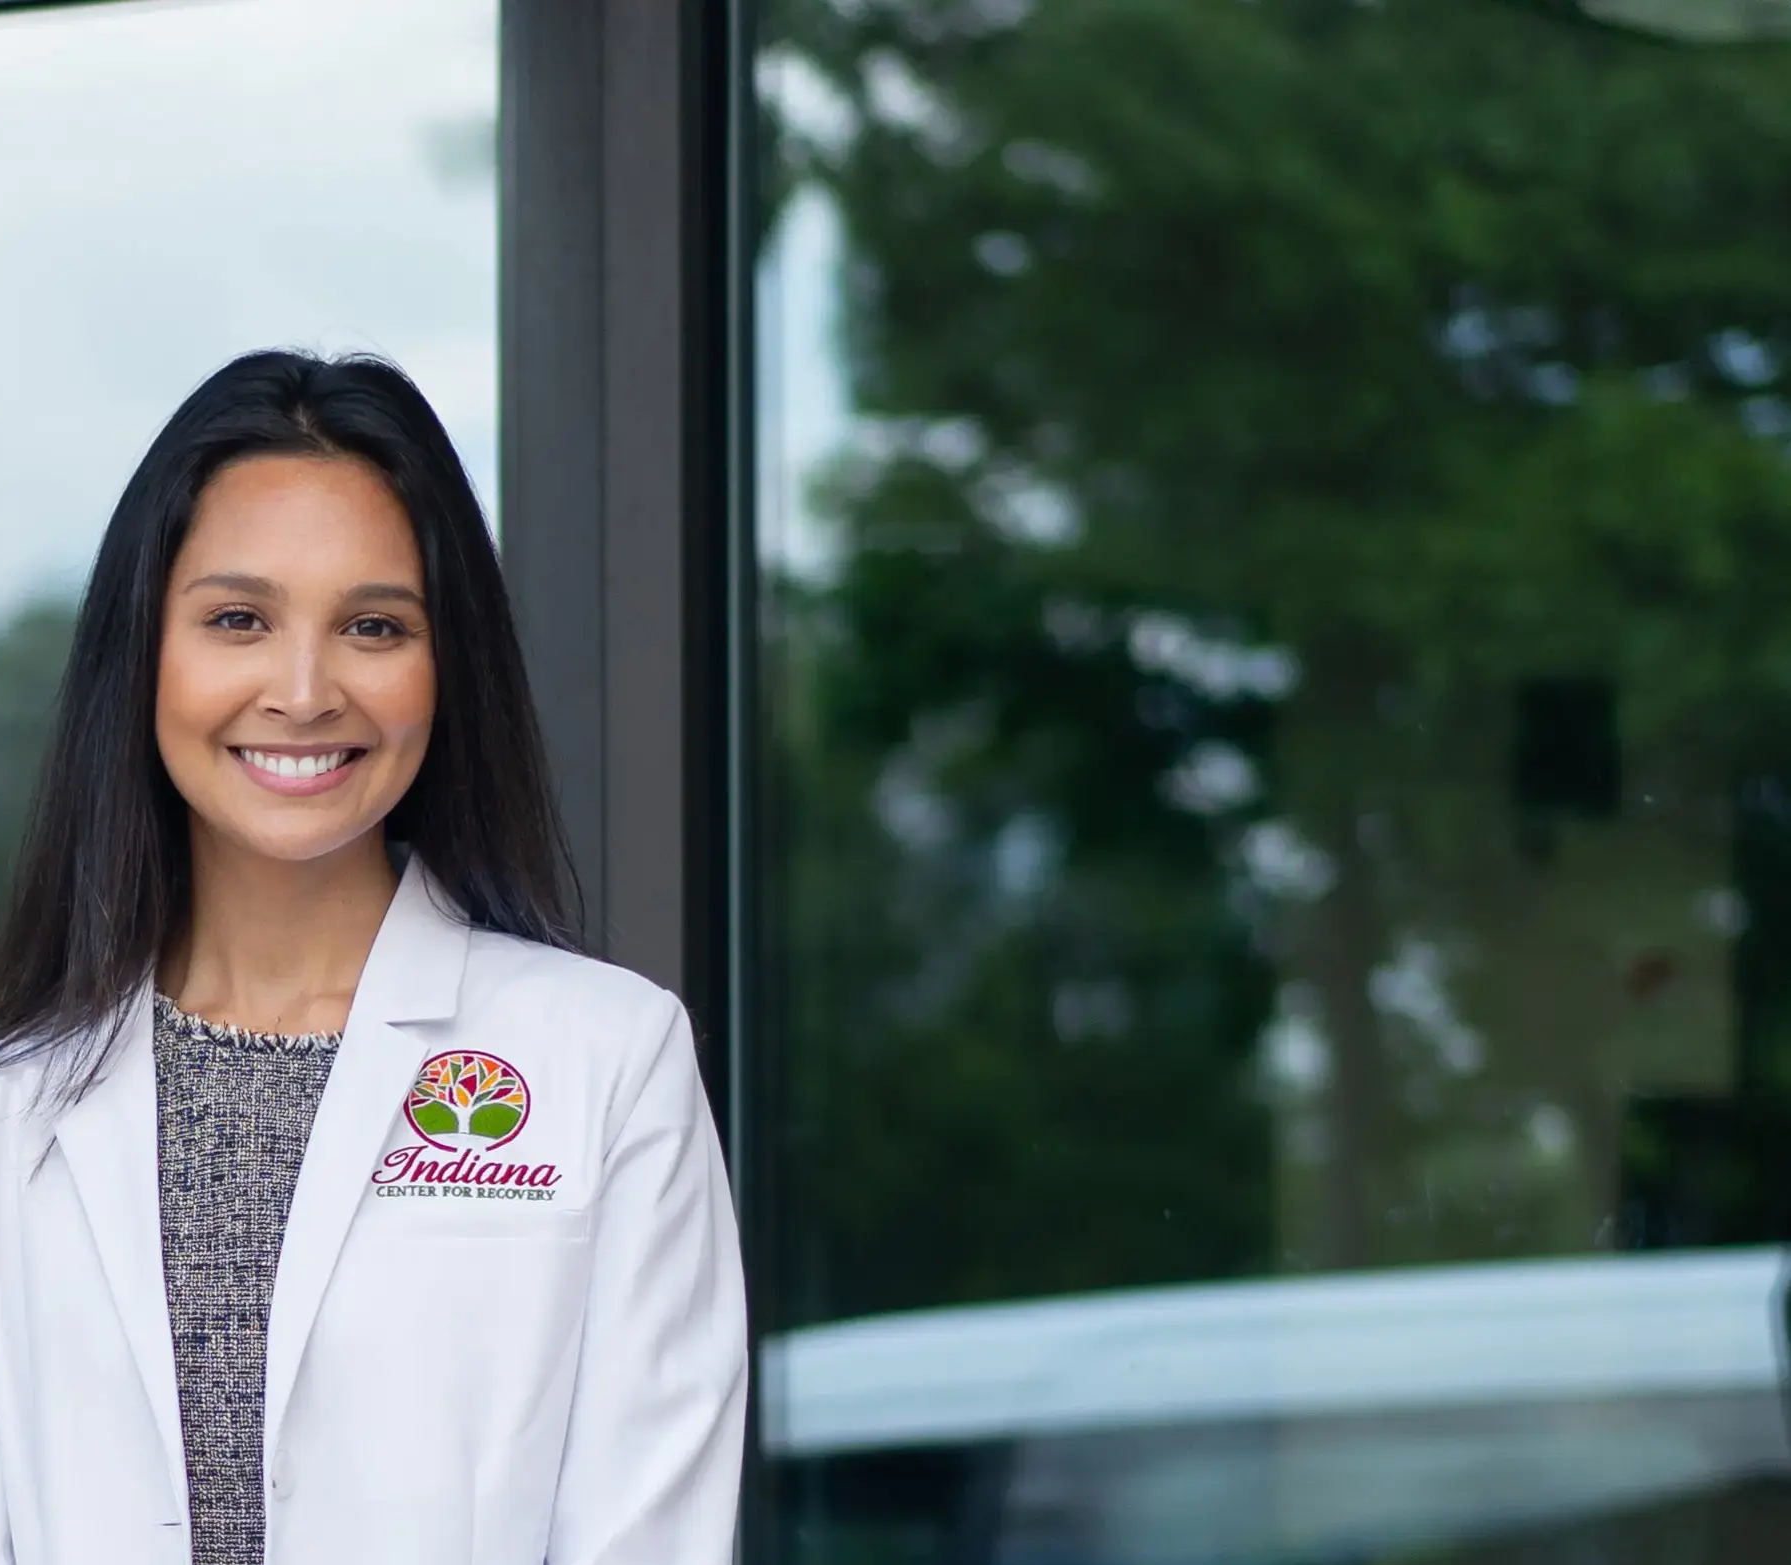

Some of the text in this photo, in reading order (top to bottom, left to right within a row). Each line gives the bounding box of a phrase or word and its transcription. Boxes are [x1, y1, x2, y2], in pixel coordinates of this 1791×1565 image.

[371, 1145, 562, 1187] Indiana
[376, 1185, 556, 1201] CENTER FOR RECOVERY
